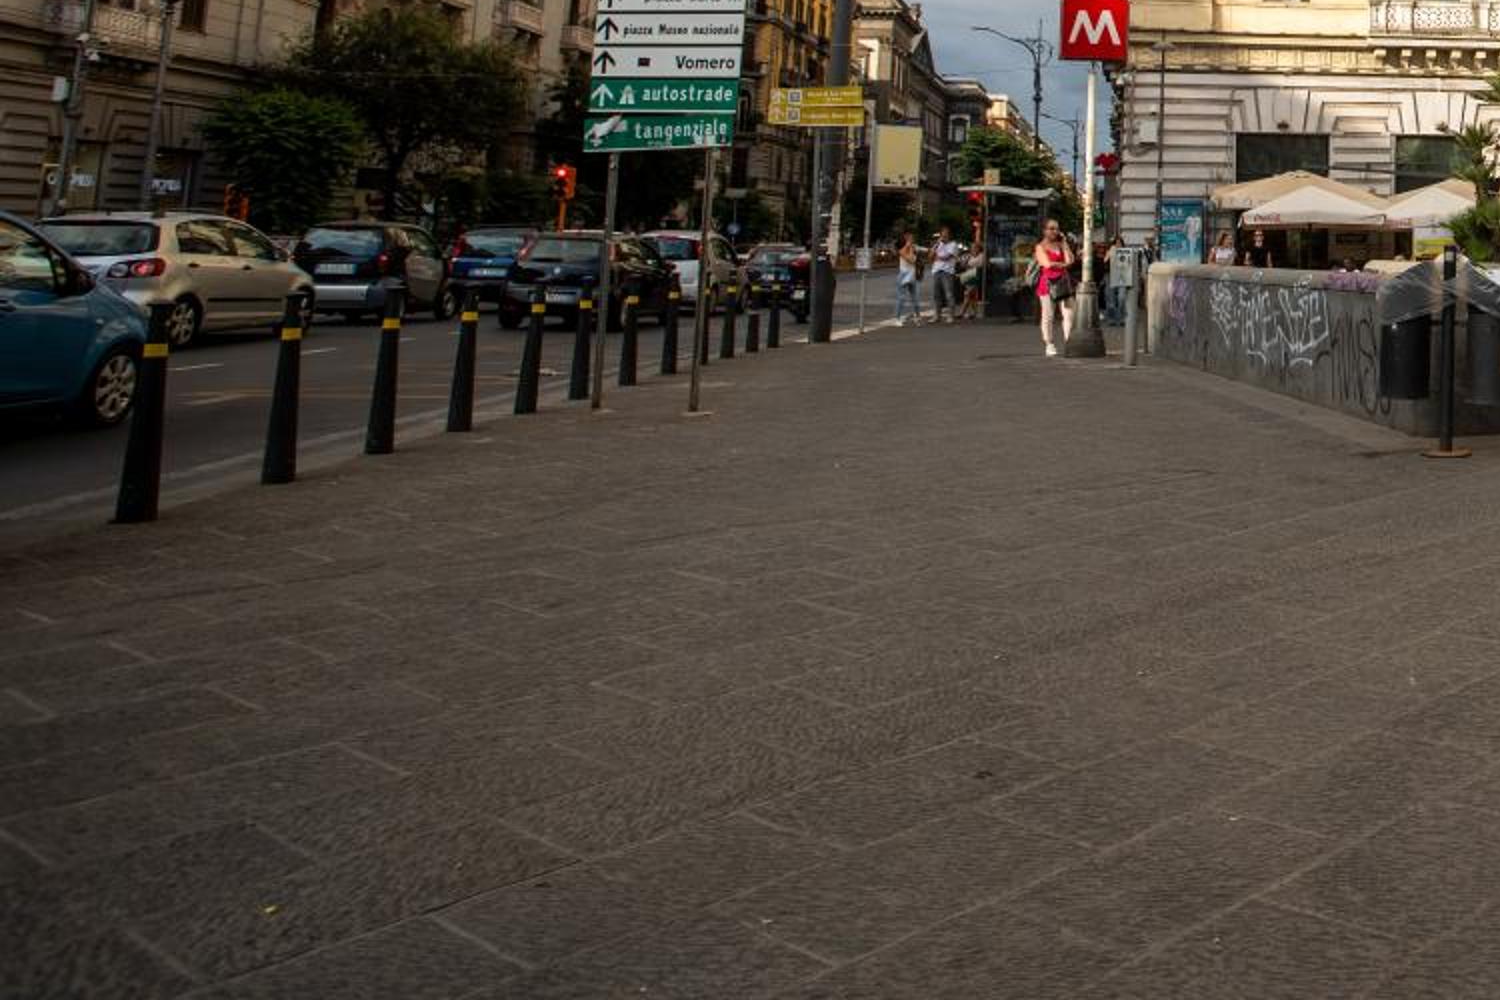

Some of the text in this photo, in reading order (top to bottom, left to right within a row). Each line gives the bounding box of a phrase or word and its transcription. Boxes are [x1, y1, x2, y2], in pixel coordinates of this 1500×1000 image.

[623, 23, 739, 38] piazza Museo nazionale
[1068, 9, 1120, 45] M
[675, 56, 735, 69] Vomero
[642, 84, 733, 101] autostrade
[635, 118, 727, 140] tangenziale
